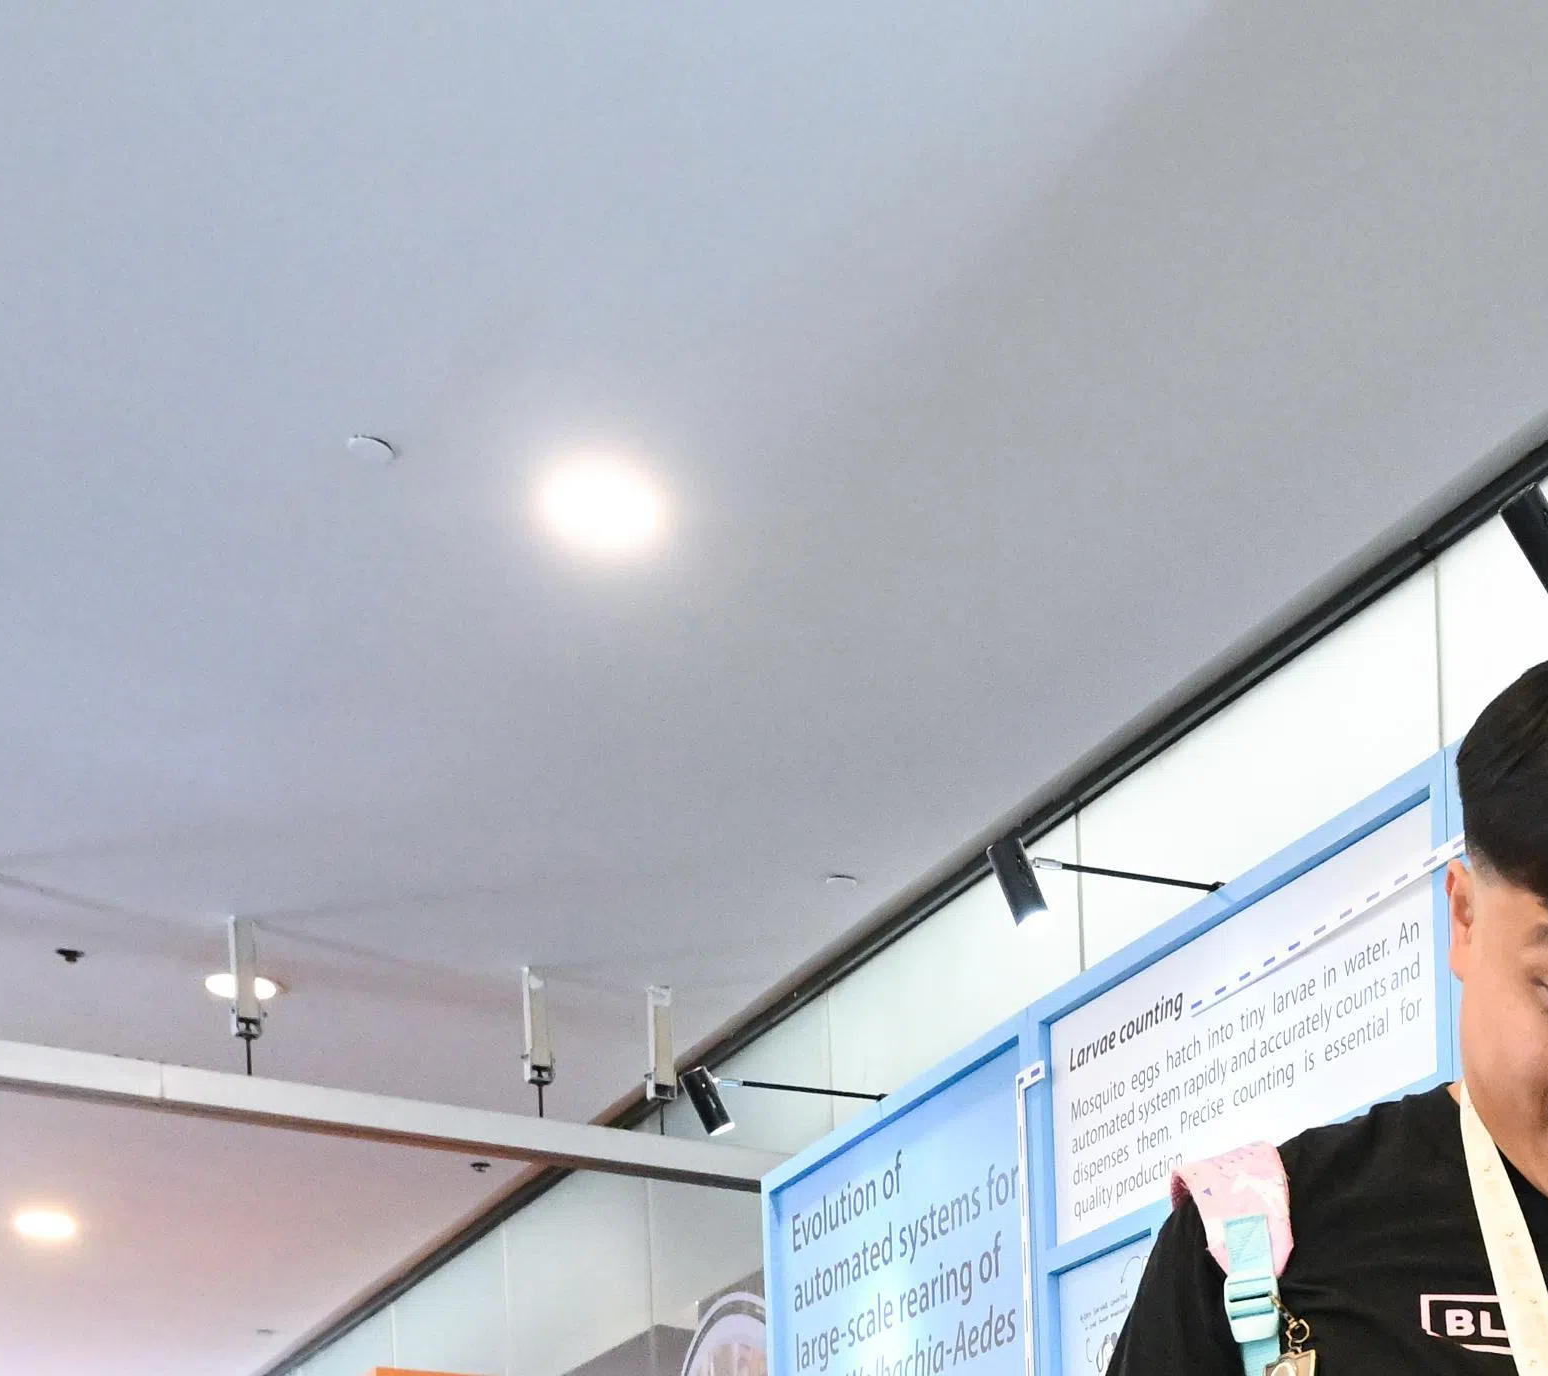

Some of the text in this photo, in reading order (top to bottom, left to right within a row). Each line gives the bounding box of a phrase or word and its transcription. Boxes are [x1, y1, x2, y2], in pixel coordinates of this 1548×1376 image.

[1069, 991, 1183, 1072] Larvae counting
[1071, 921, 1420, 1122] Mosquito eggs hatch into tiny larvae in water. An
[792, 1150, 902, 1253] Evolution of
[794, 1163, 1018, 1313] automated systems for
[796, 1231, 1002, 1373] large-scale rearing of
